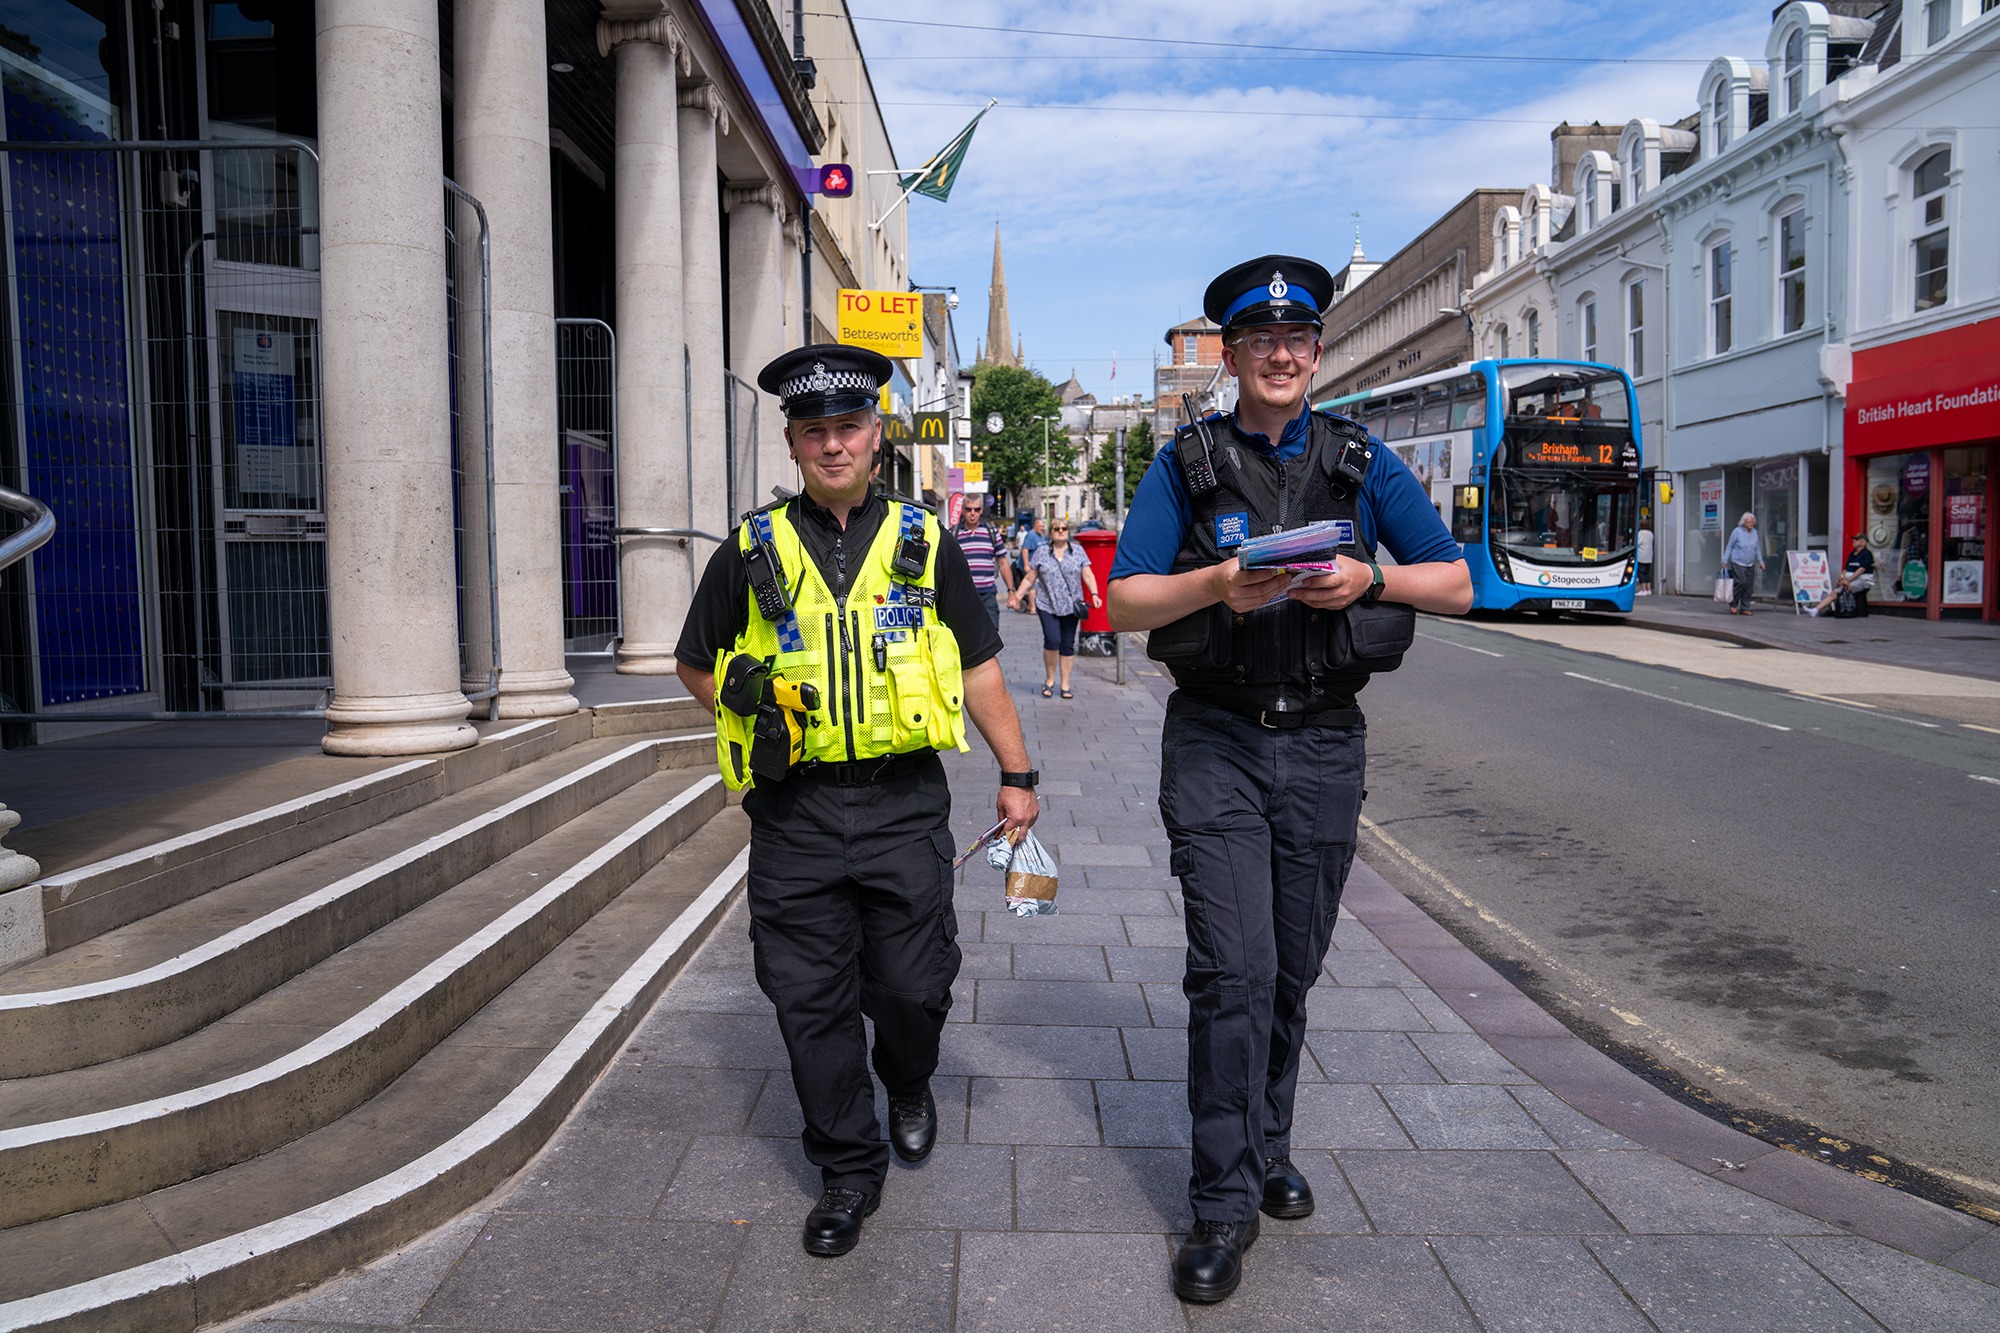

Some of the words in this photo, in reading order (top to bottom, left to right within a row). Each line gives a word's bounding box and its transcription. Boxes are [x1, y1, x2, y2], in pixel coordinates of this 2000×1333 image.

[842, 294, 871, 312] TO
[881, 296, 918, 314] LET
[842, 327, 920, 342] Bettesworths
[1858, 403, 1896, 424] British
[1897, 398, 1933, 418] Heart
[1935, 384, 2000, 412] Foundati
[1542, 443, 1579, 455] Brixham
[1599, 444, 1613, 464] 12
[1701, 491, 1709, 501] TO
[1710, 490, 1722, 500] LET
[951, 496, 964, 525] OPEN
[1951, 504, 1977, 515] Sale
[1220, 533, 1245, 543] 30778
[1552, 575, 1600, 585] Stagecoach
[878, 608, 921, 626] POLICE
